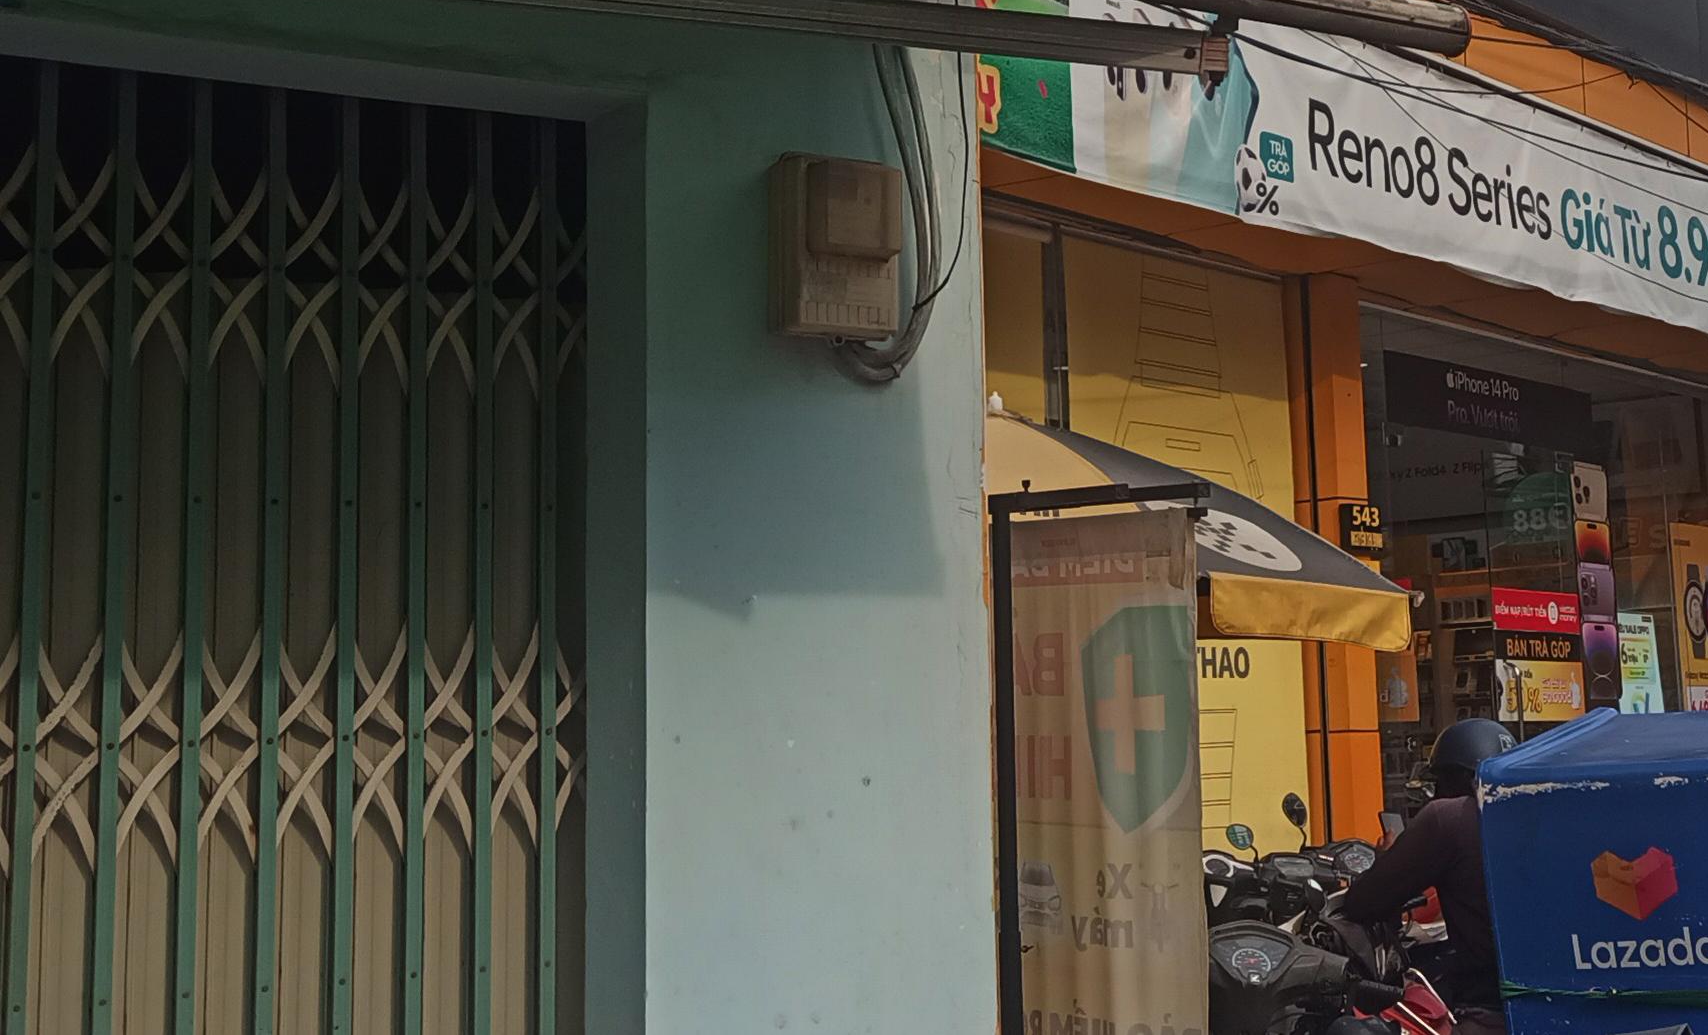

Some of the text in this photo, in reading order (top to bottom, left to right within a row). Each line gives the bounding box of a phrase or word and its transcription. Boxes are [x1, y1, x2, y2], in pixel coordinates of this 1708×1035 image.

[1269, 135, 1288, 160] TRẢ
[1267, 155, 1291, 177] GÓP
[1308, 97, 1440, 207] Reno8
[1446, 146, 1553, 241] Series
[1560, 188, 1615, 258] Giá
[1614, 204, 1652, 271] Từ
[1454, 369, 1490, 396] iPhone
[1502, 380, 1520, 402] Pro
[1352, 505, 1380, 528] 543
